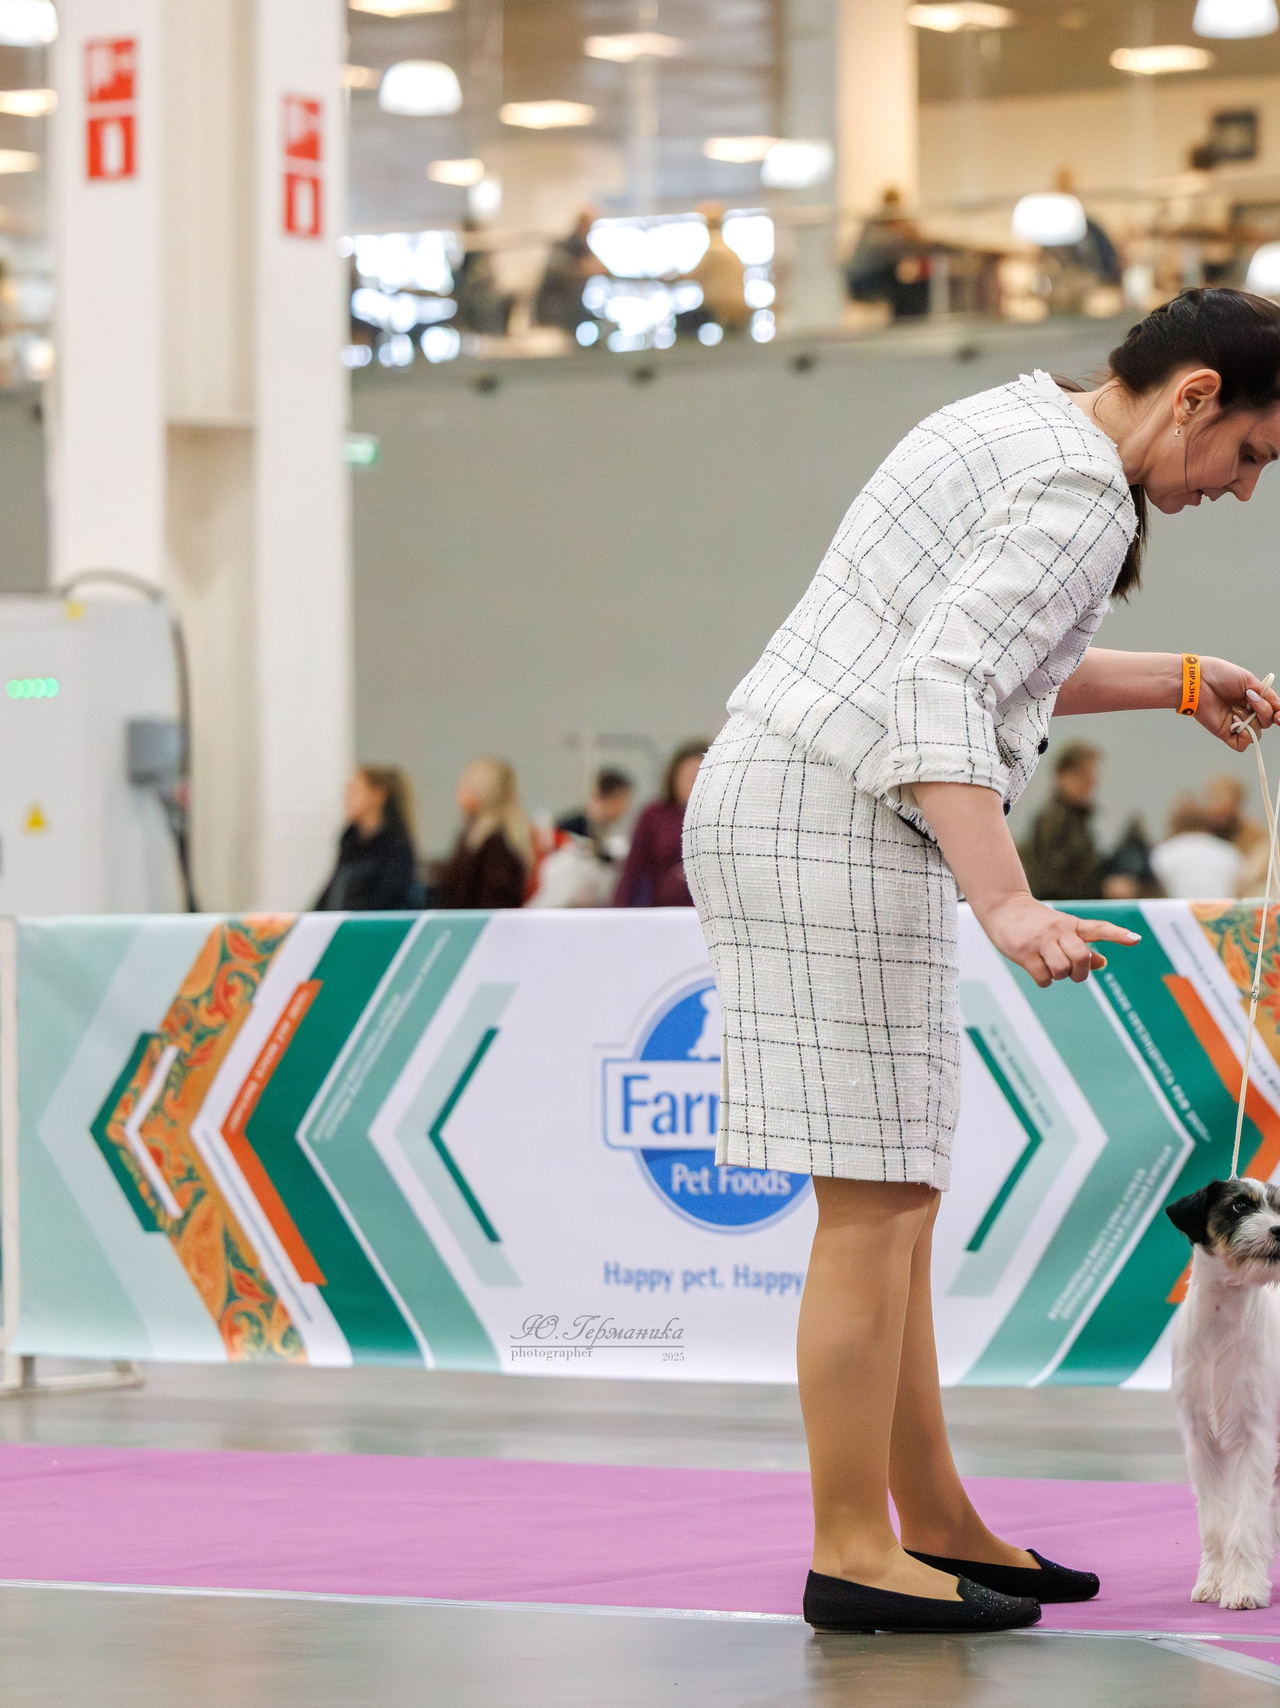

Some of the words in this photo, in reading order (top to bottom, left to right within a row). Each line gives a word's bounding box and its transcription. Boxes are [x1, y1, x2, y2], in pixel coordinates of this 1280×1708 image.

[1188, 666, 1196, 703] ЕВРАЗИЯ
[622, 1074, 720, 1135] Far
[670, 1162, 712, 1195] Pet
[718, 1165, 792, 1196] Foods
[603, 1261, 673, 1293] Happy
[682, 1264, 724, 1293] pet.
[733, 1263, 807, 1296] Happy
